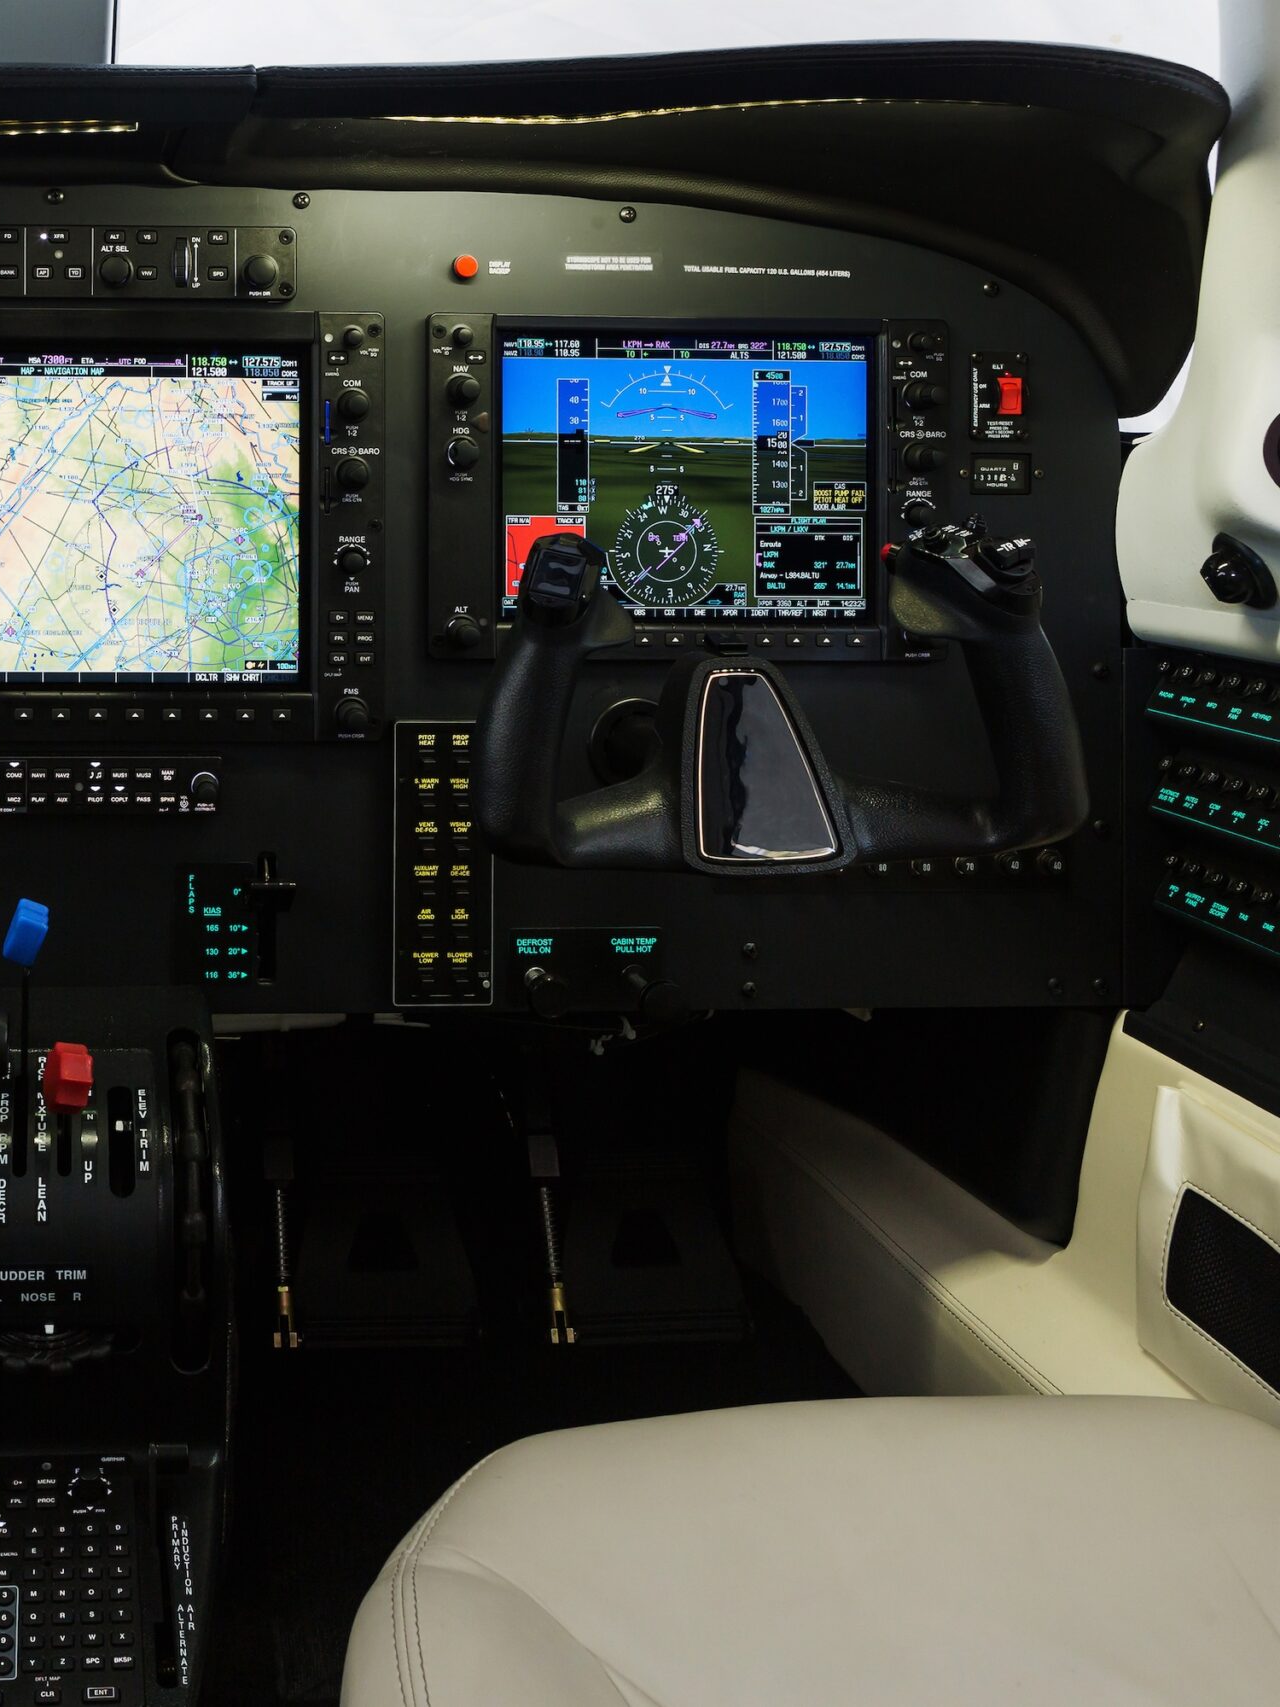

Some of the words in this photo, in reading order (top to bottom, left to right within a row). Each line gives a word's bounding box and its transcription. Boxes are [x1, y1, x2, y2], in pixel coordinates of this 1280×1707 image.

[725, 266, 738, 274] FUEL
[740, 267, 765, 275] CAPACITY
[830, 270, 850, 278] LITERS)
[192, 357, 226, 366] 118.750
[245, 358, 279, 366] 127.575
[21, 367, 33, 375] MAP
[44, 367, 88, 375] NAVIGATION
[91, 367, 104, 375] MAP
[138, 1089, 146, 1119] ELEV
[139, 1129, 149, 1172] TRIM
[38, 1178, 46, 1222] LEAN
[56, 1270, 86, 1280] TRIM
[21, 1293, 56, 1302] NOSE
[182, 1521, 192, 1595] INDUCTION
[187, 1604, 195, 1630] AIR
[172, 1516, 181, 1570] PRIMARY
[178, 1605, 188, 1685] ALTERNATE
